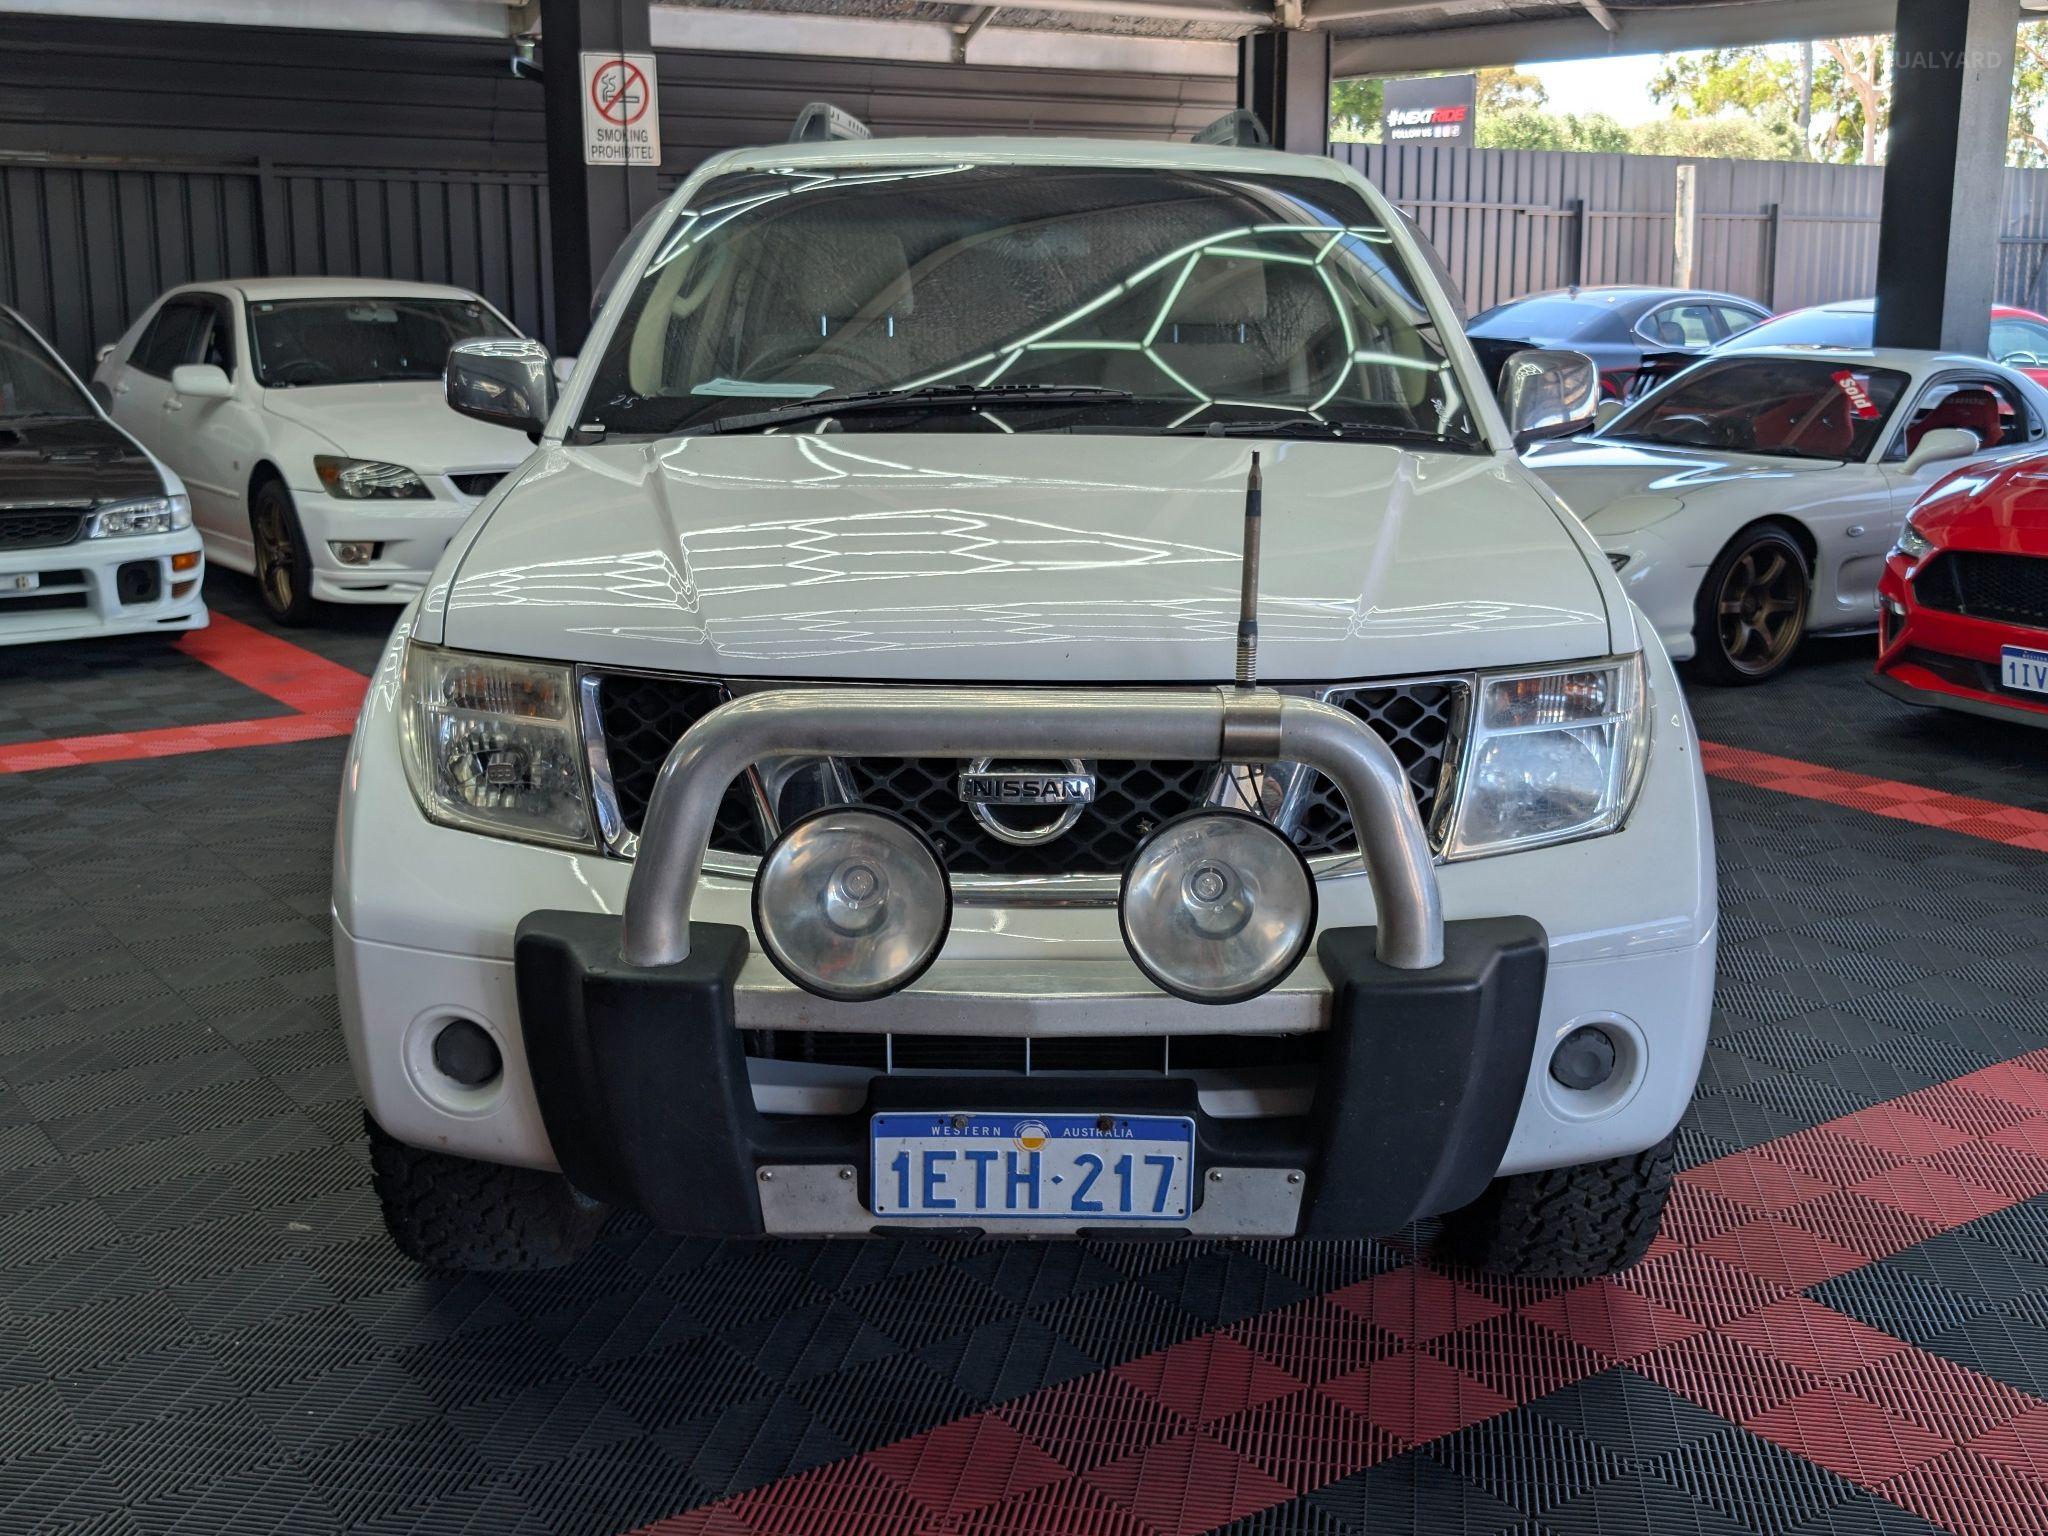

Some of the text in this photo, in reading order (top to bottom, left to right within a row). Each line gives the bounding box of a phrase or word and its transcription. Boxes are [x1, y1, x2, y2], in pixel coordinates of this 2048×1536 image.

[1387, 105, 1466, 127] #NEXTRIDE
[597, 128, 648, 143] SMOKING
[1391, 126, 1433, 139] FOLLOW US
[591, 145, 655, 160] PROHIBITED
[1839, 378, 1872, 408] Sold
[973, 779, 1082, 798] NISSAN
[931, 1125, 1134, 1139] WESTERN AUSTRALIA
